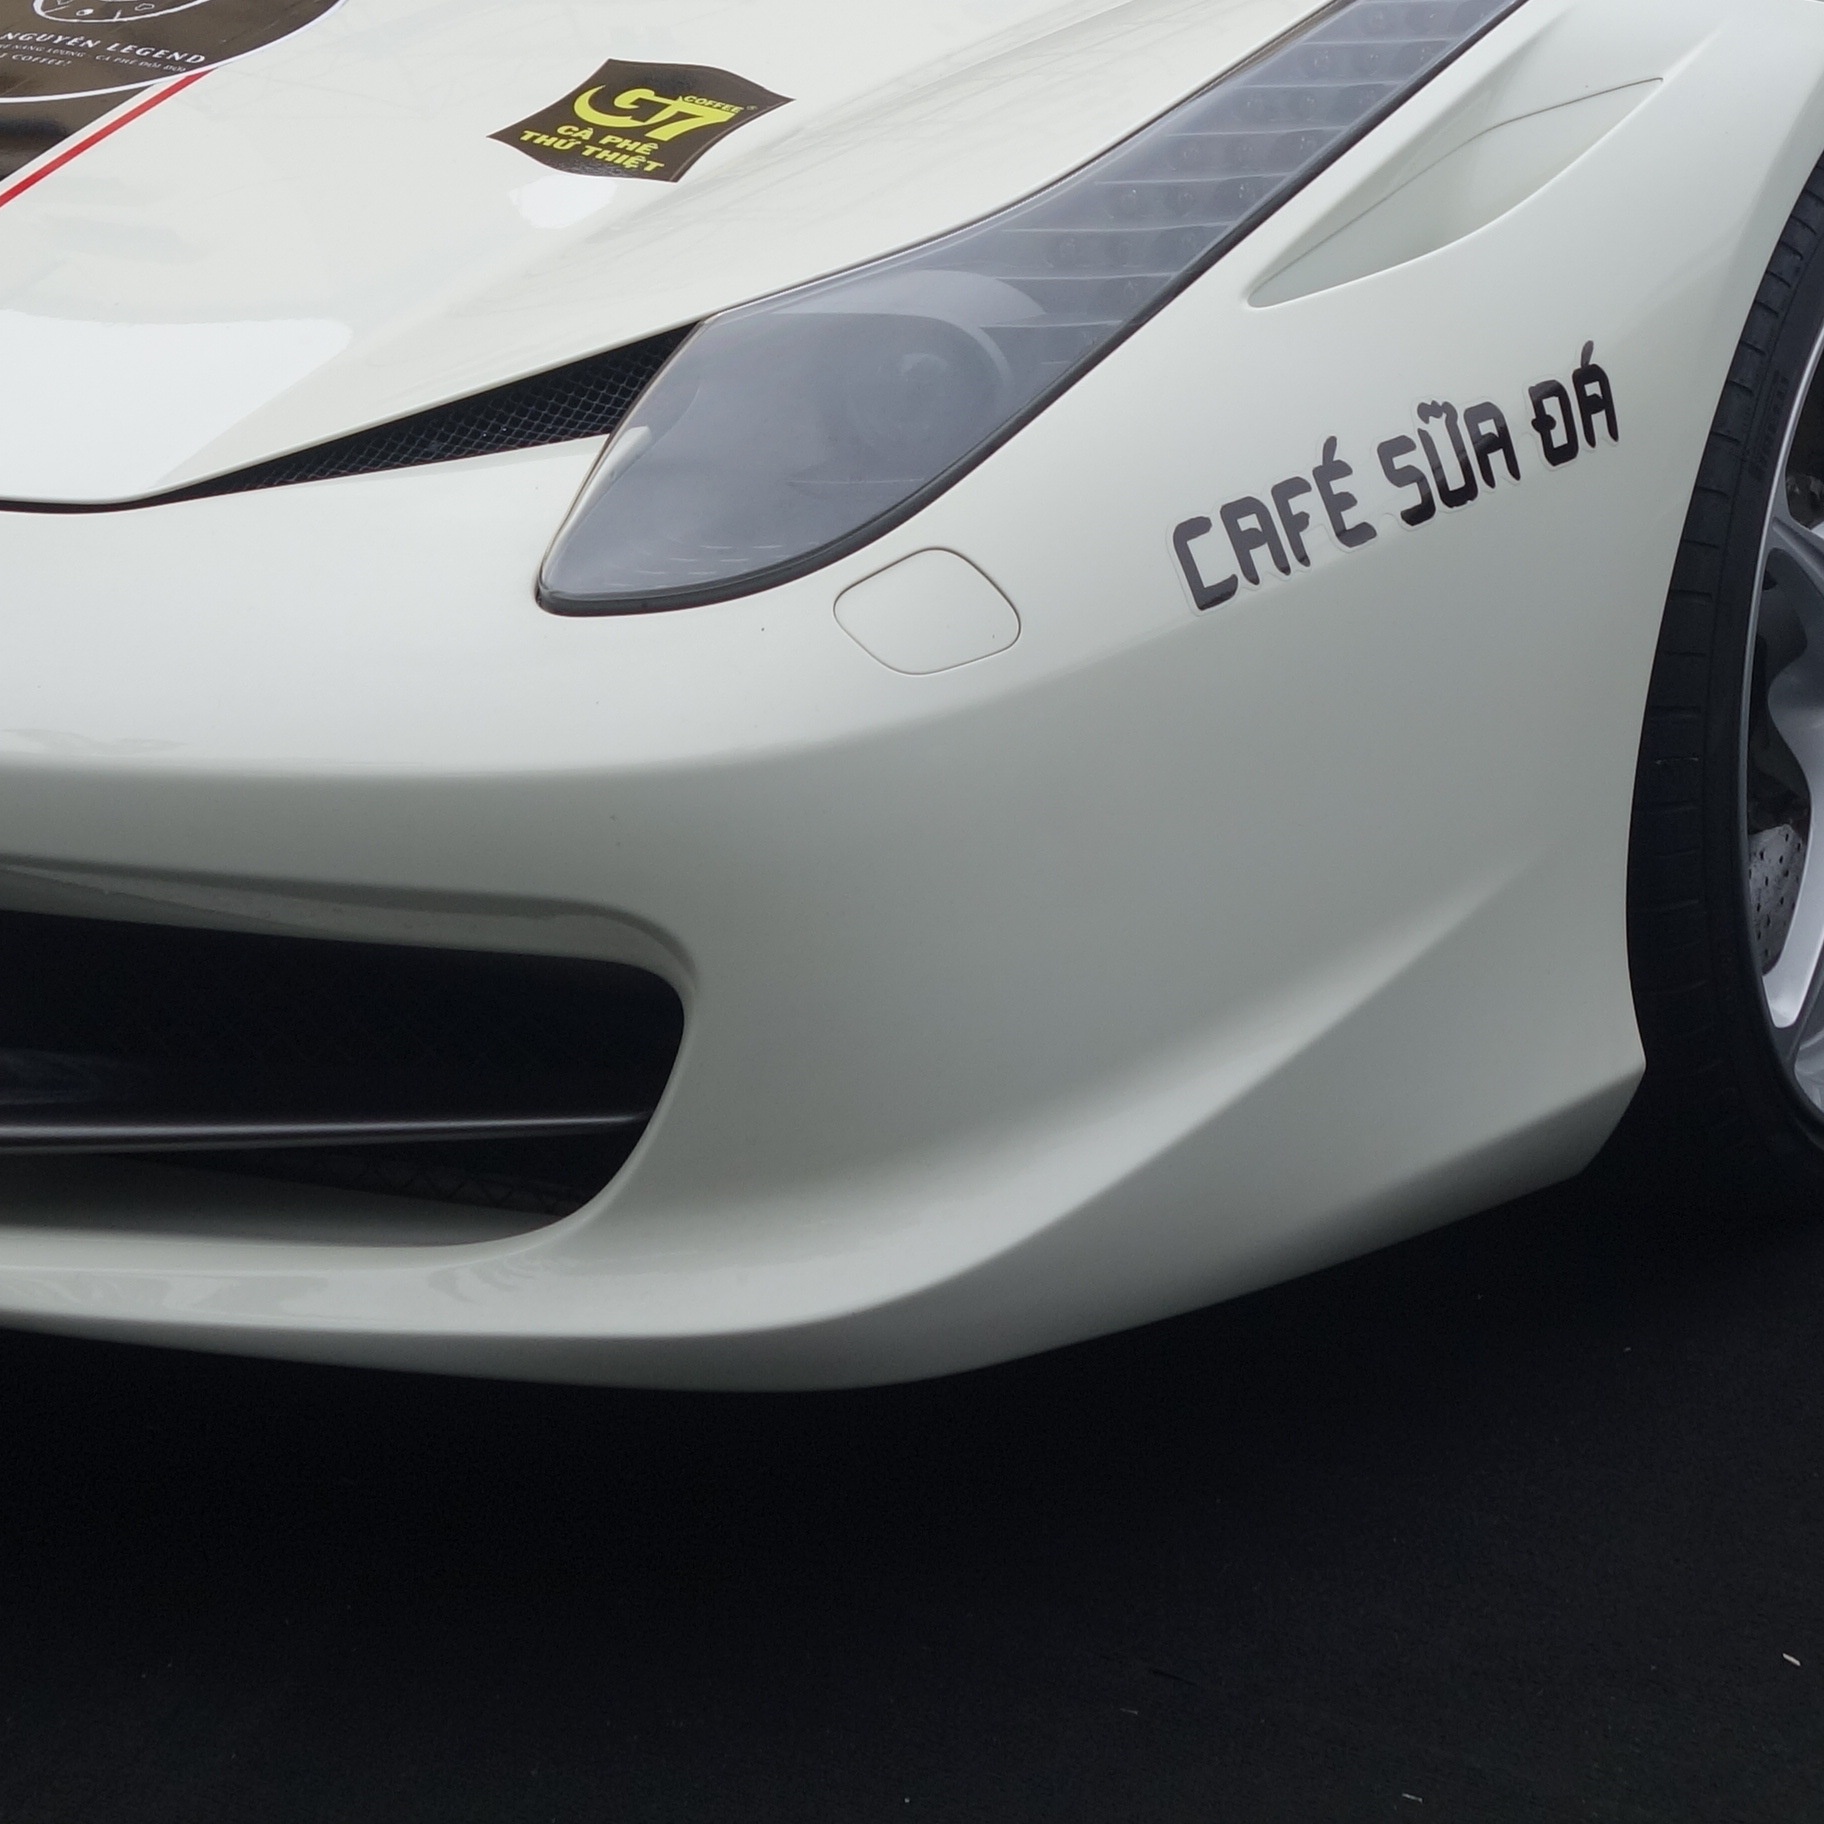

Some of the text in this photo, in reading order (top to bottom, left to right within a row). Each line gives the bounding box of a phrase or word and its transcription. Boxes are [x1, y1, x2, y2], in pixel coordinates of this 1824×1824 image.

[0, 31, 101, 49] NGUYÊN
[106, 42, 206, 64] LEGEND
[573, 84, 736, 142] G7
[682, 94, 744, 114] COFFEE
[520, 129, 665, 172] THỨ THIỆT
[556, 124, 660, 156] CÀ PHÊ
[1172, 435, 1377, 611] CAFÉ
[1377, 400, 1521, 527] SỮA
[1528, 340, 1619, 467] ĐÁ
